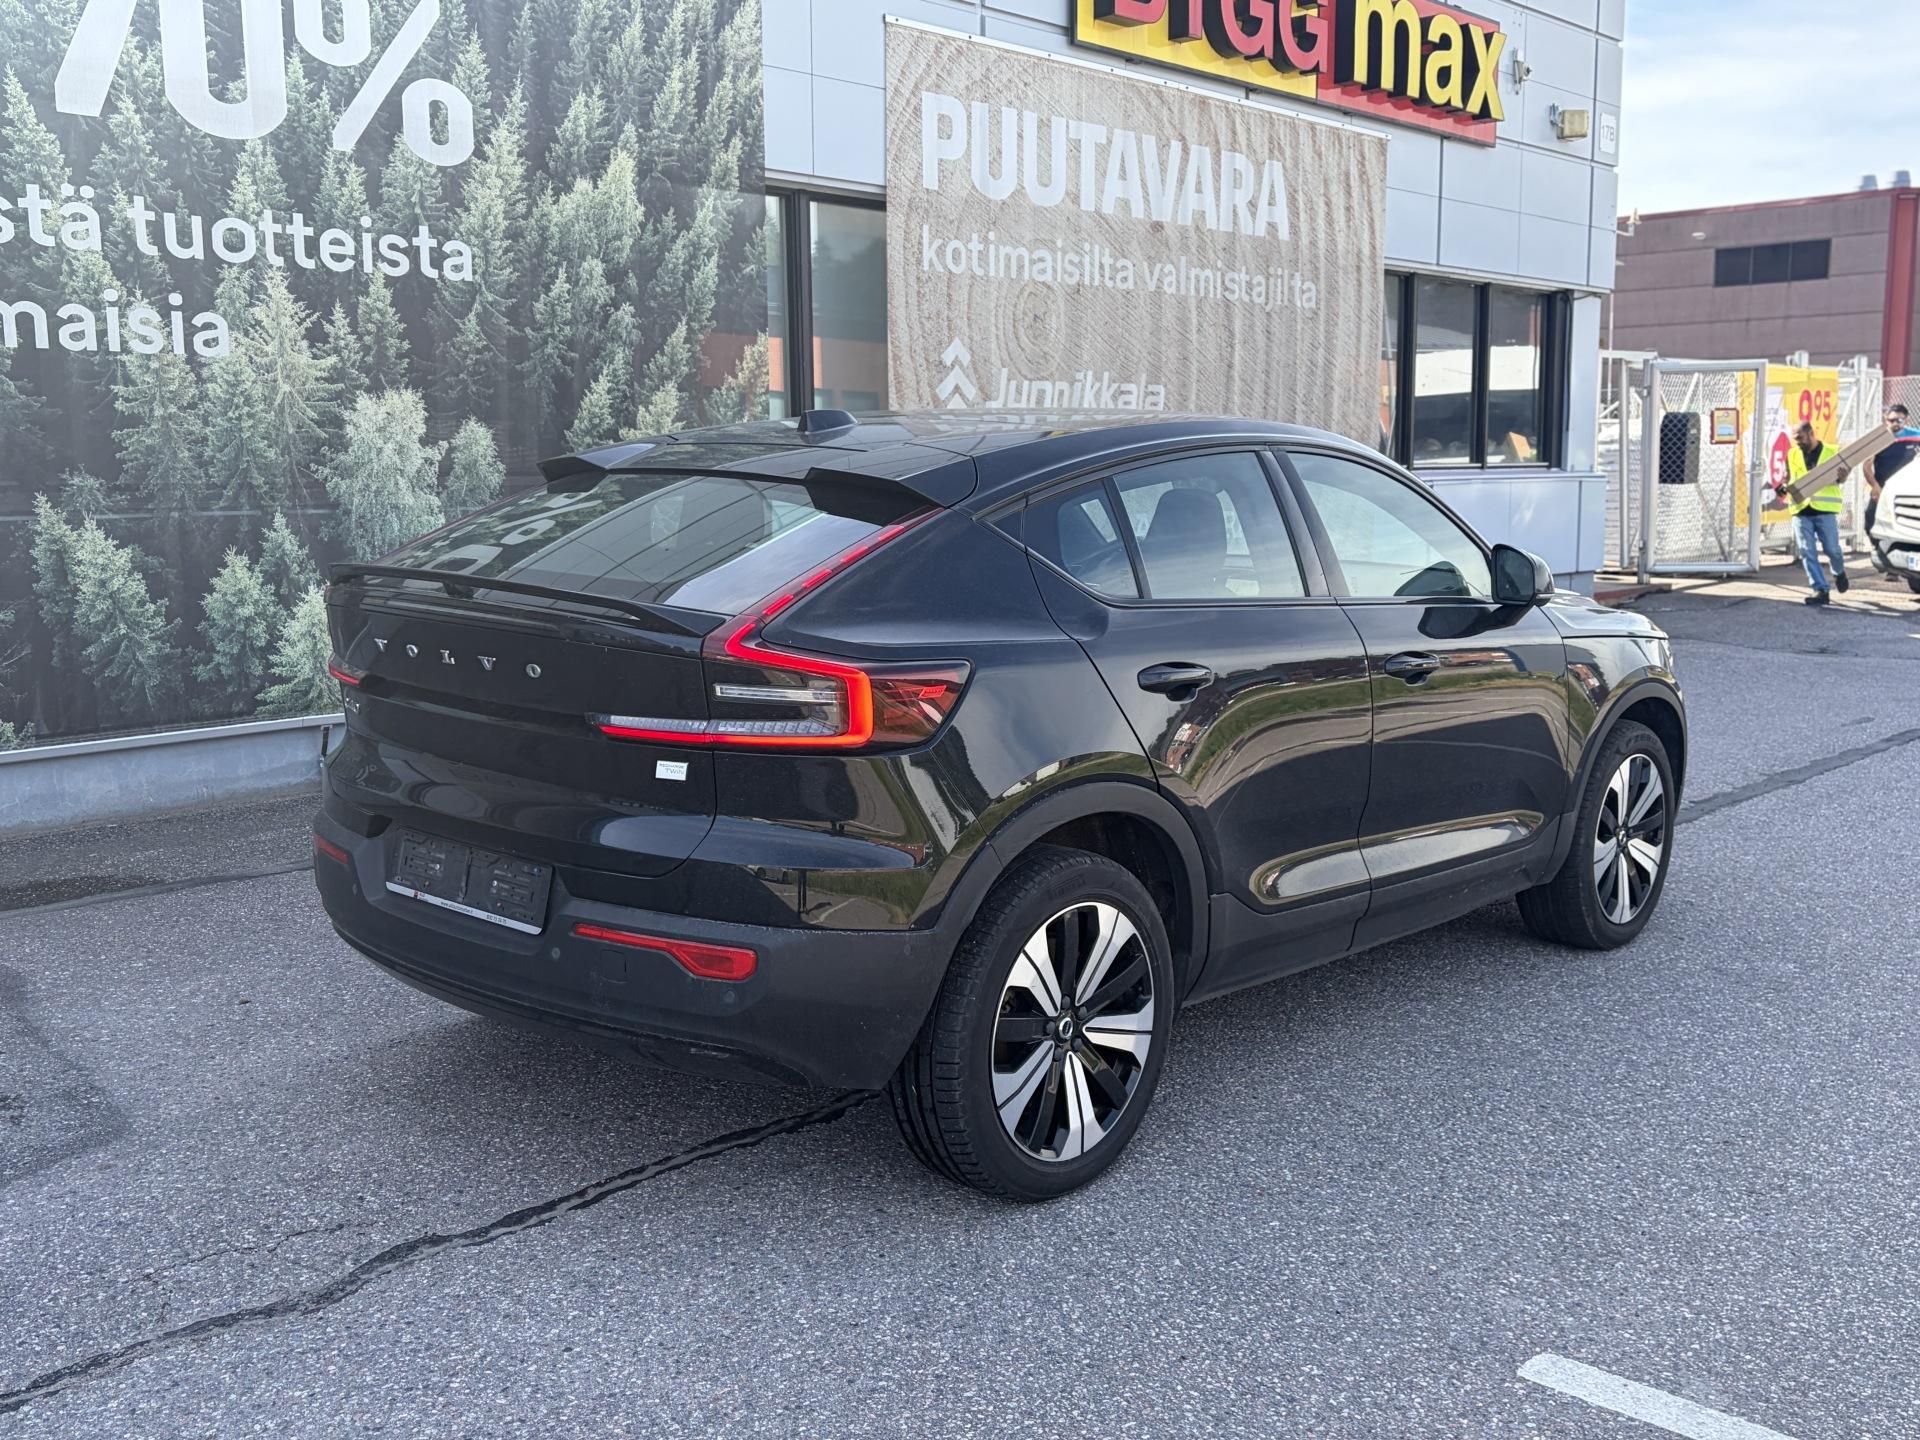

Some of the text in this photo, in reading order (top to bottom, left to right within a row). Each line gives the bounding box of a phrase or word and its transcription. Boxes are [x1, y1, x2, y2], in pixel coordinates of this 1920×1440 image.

[1115, 0, 1508, 122] GG max
[921, 91, 1290, 241] PUUTAVARA
[1601, 124, 1615, 141] 17B
[126, 196, 475, 283] tuotteista
[921, 224, 1317, 312] kotimaisilta valmistajilta
[985, 368, 1165, 411] Junnikkala
[374, 638, 542, 678] VOLVO
